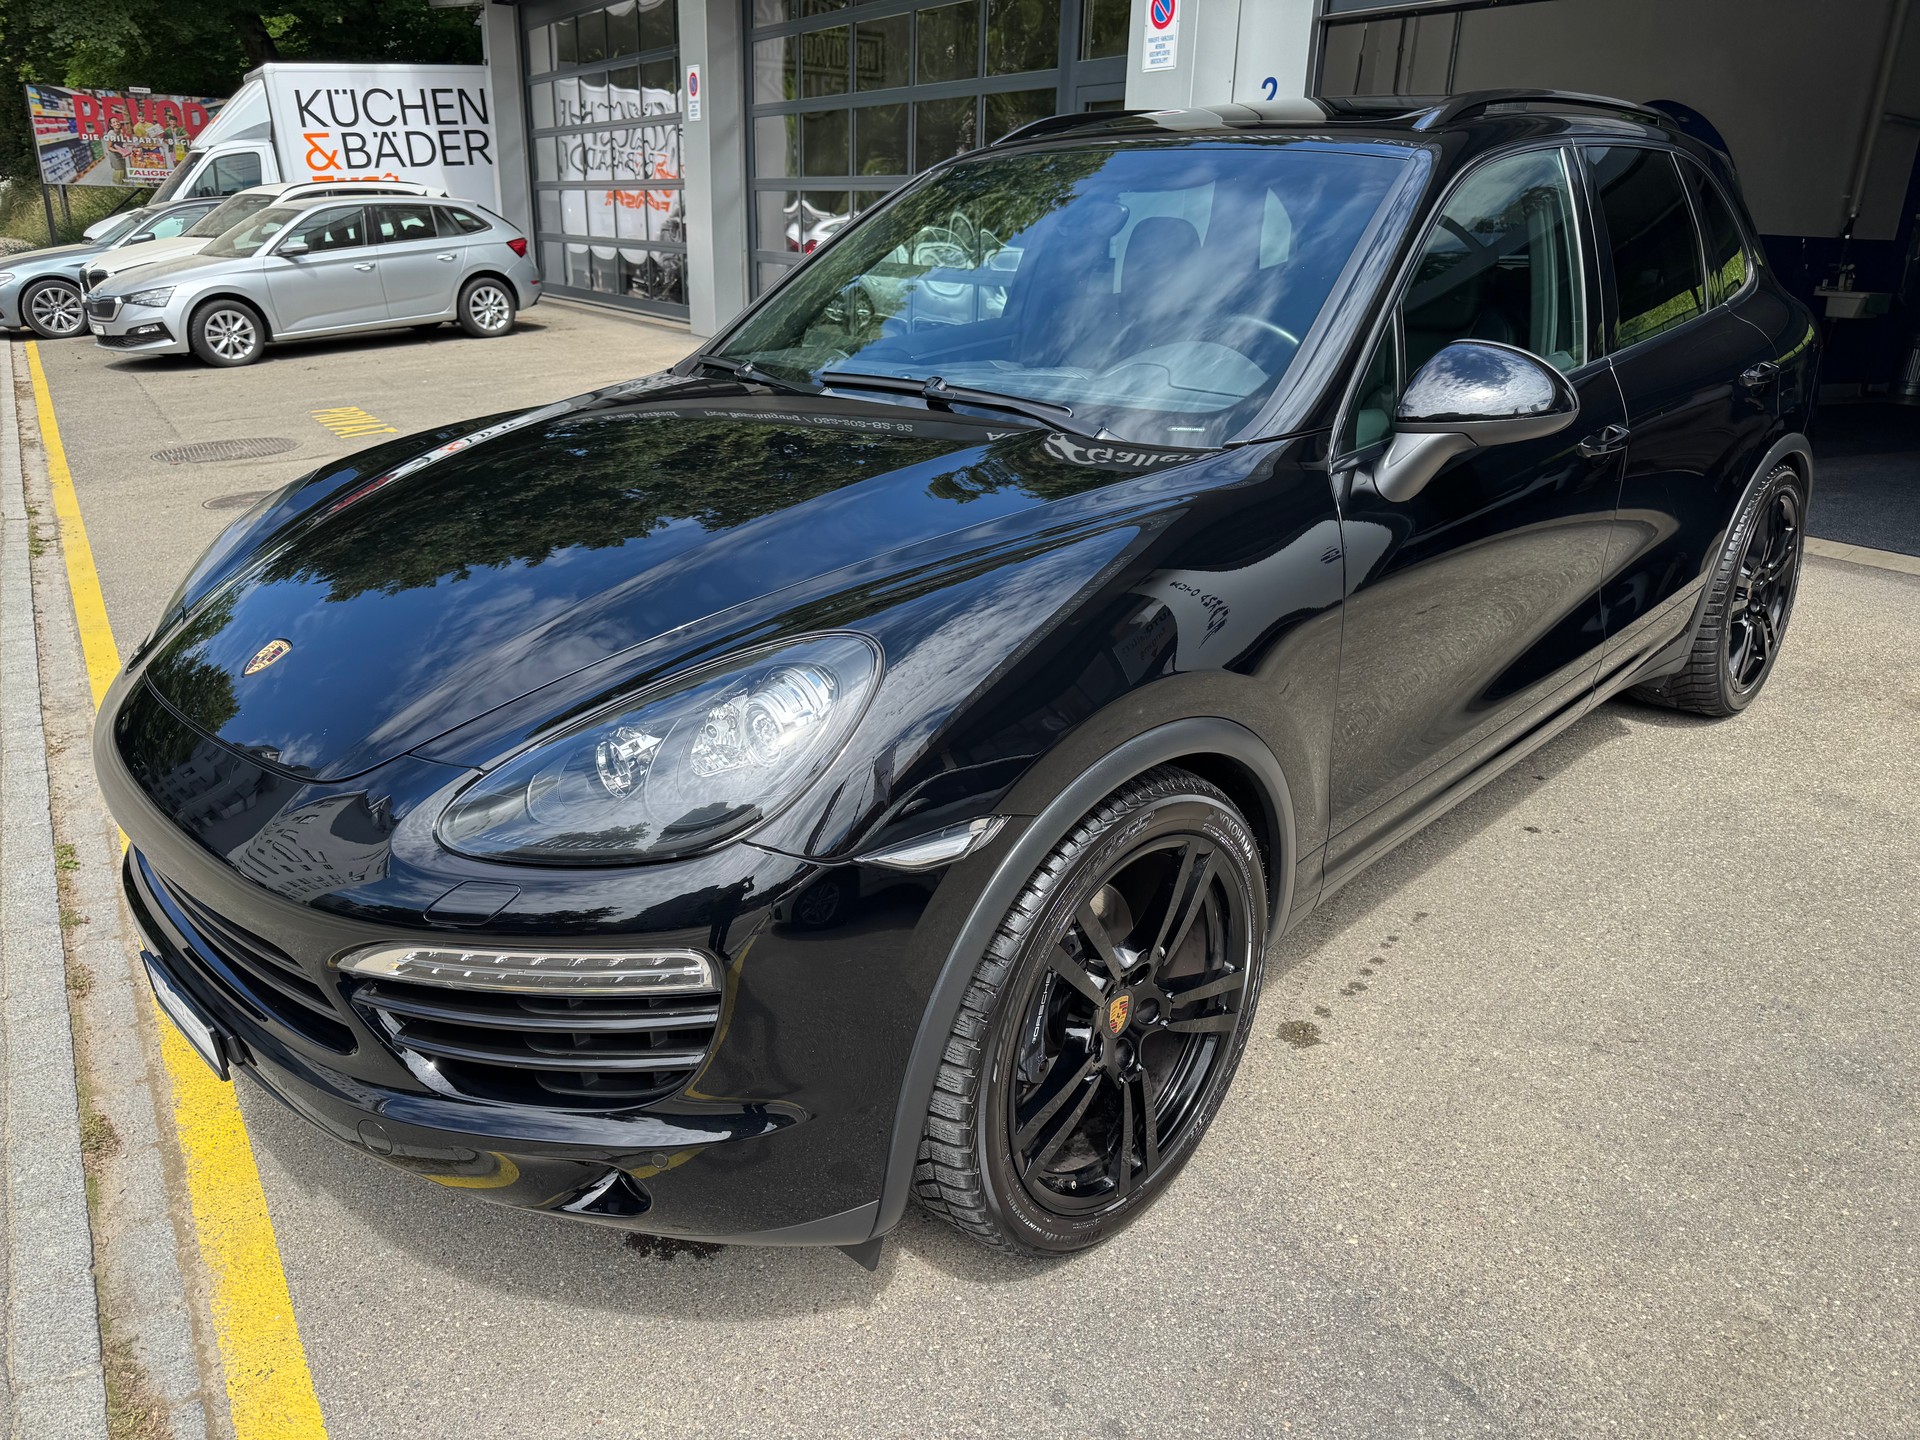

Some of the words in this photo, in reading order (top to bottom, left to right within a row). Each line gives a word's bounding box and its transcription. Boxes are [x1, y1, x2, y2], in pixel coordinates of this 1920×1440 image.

[1261, 76, 1278, 101] 2
[294, 87, 490, 128] KÜCHEN
[82, 133, 99, 141] DIE
[103, 134, 164, 145] GRILLPARTY
[1219, 812, 1255, 862] YOKOHAMA
[1031, 972, 1053, 1045] PORSCHE
[1018, 1214, 1043, 1234] WINTER
